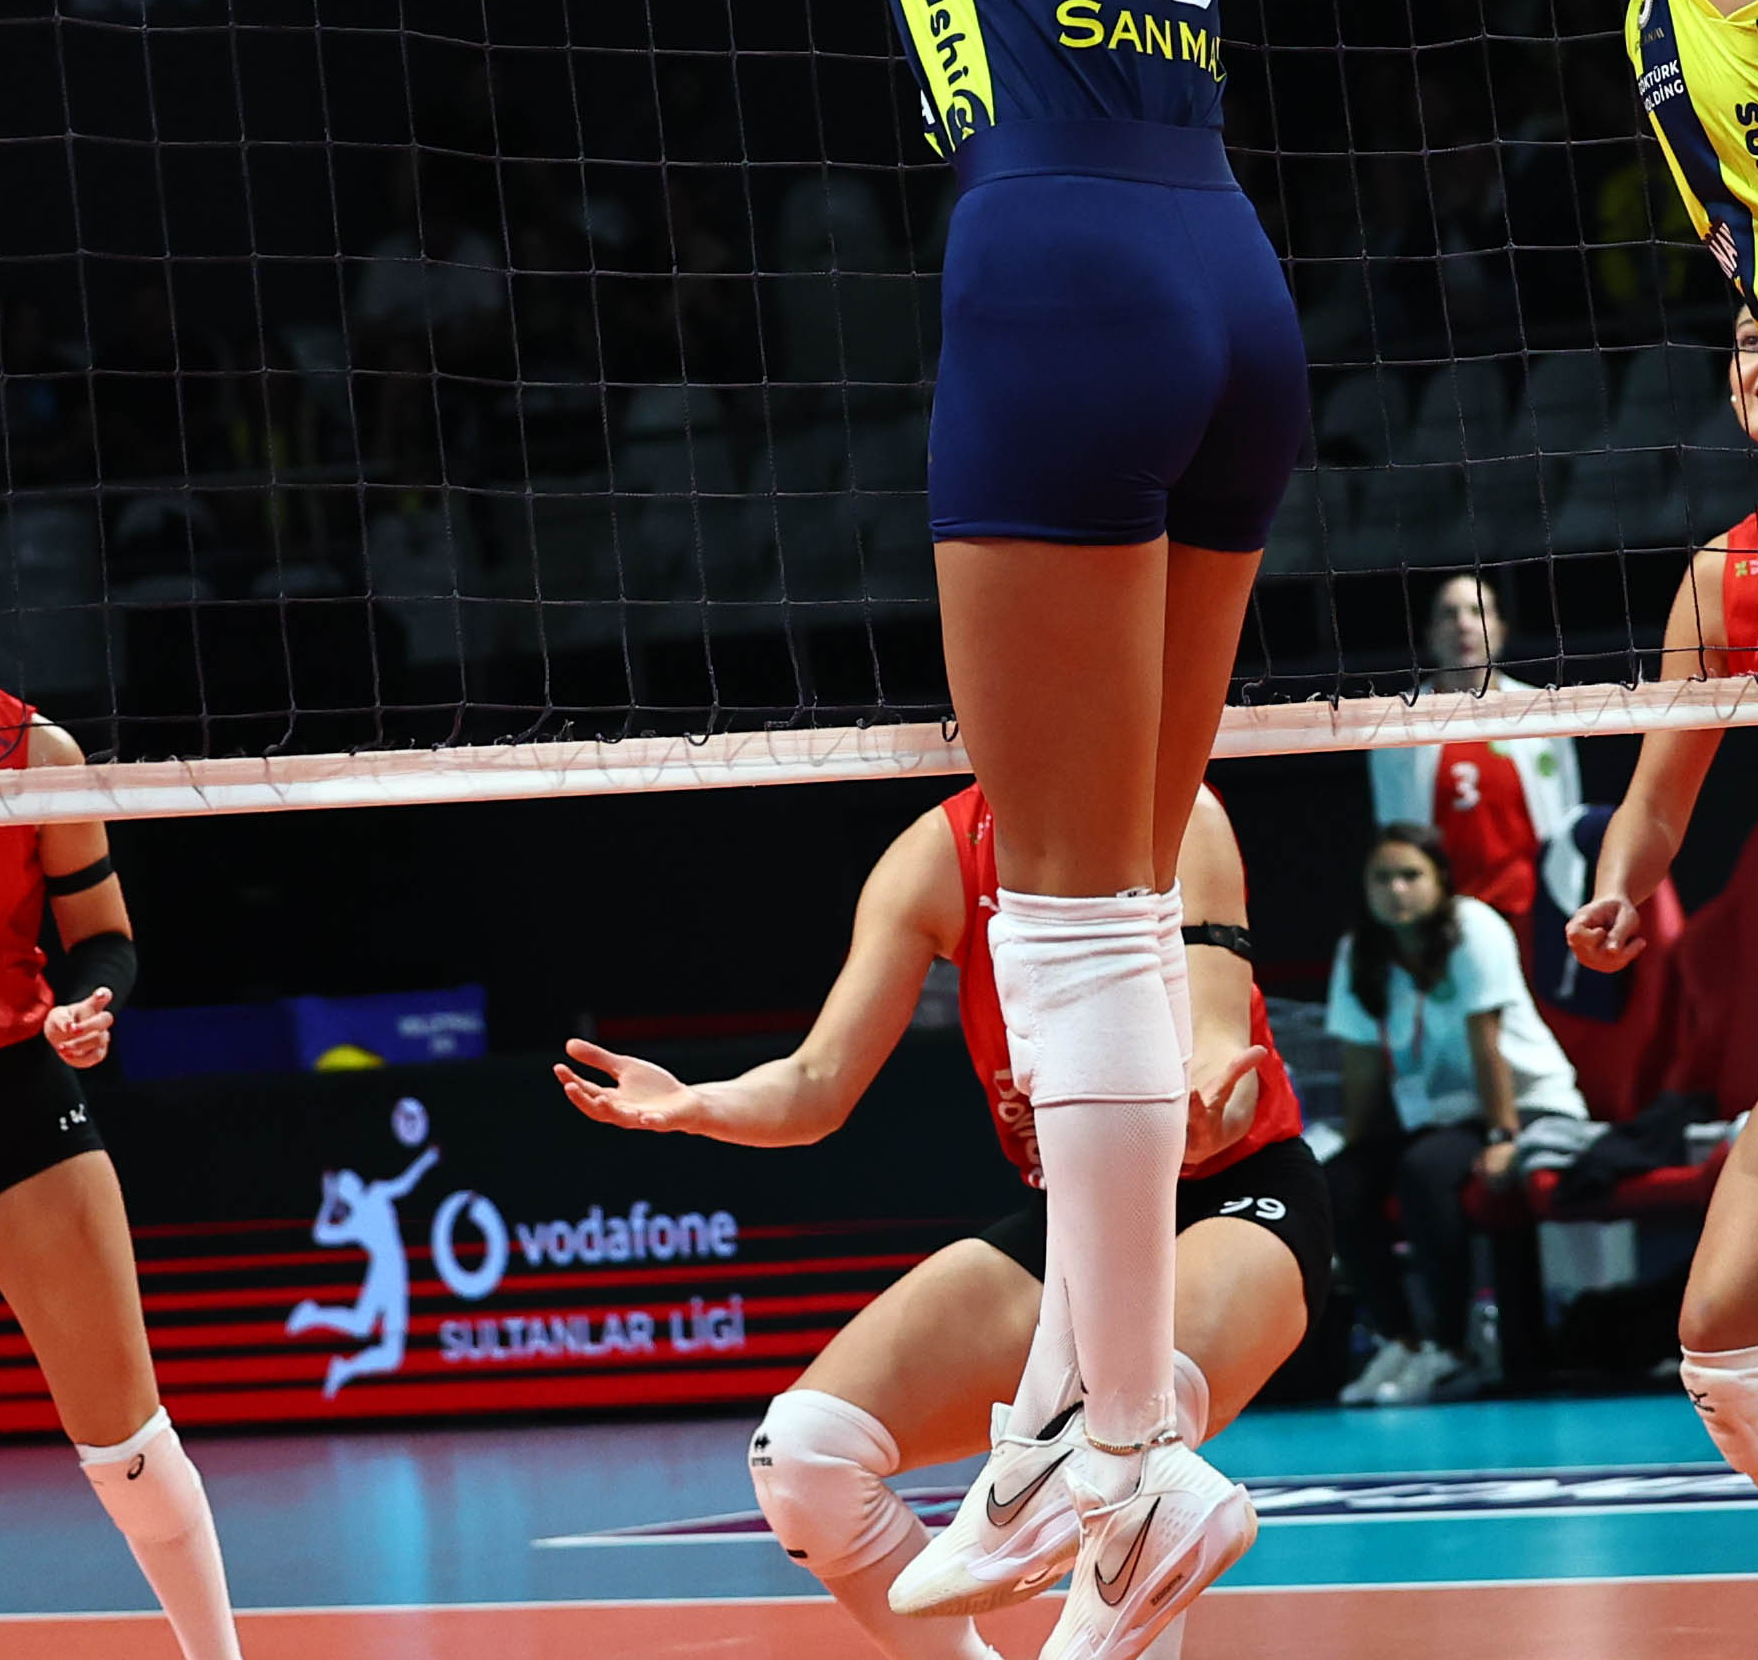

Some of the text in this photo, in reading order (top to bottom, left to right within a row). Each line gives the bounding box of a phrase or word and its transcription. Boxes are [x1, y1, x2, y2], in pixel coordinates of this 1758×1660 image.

[1450, 761, 1482, 811] 3
[515, 1200, 738, 1266] vodafone
[439, 1293, 745, 1363] SULTANLAR LİGİ
